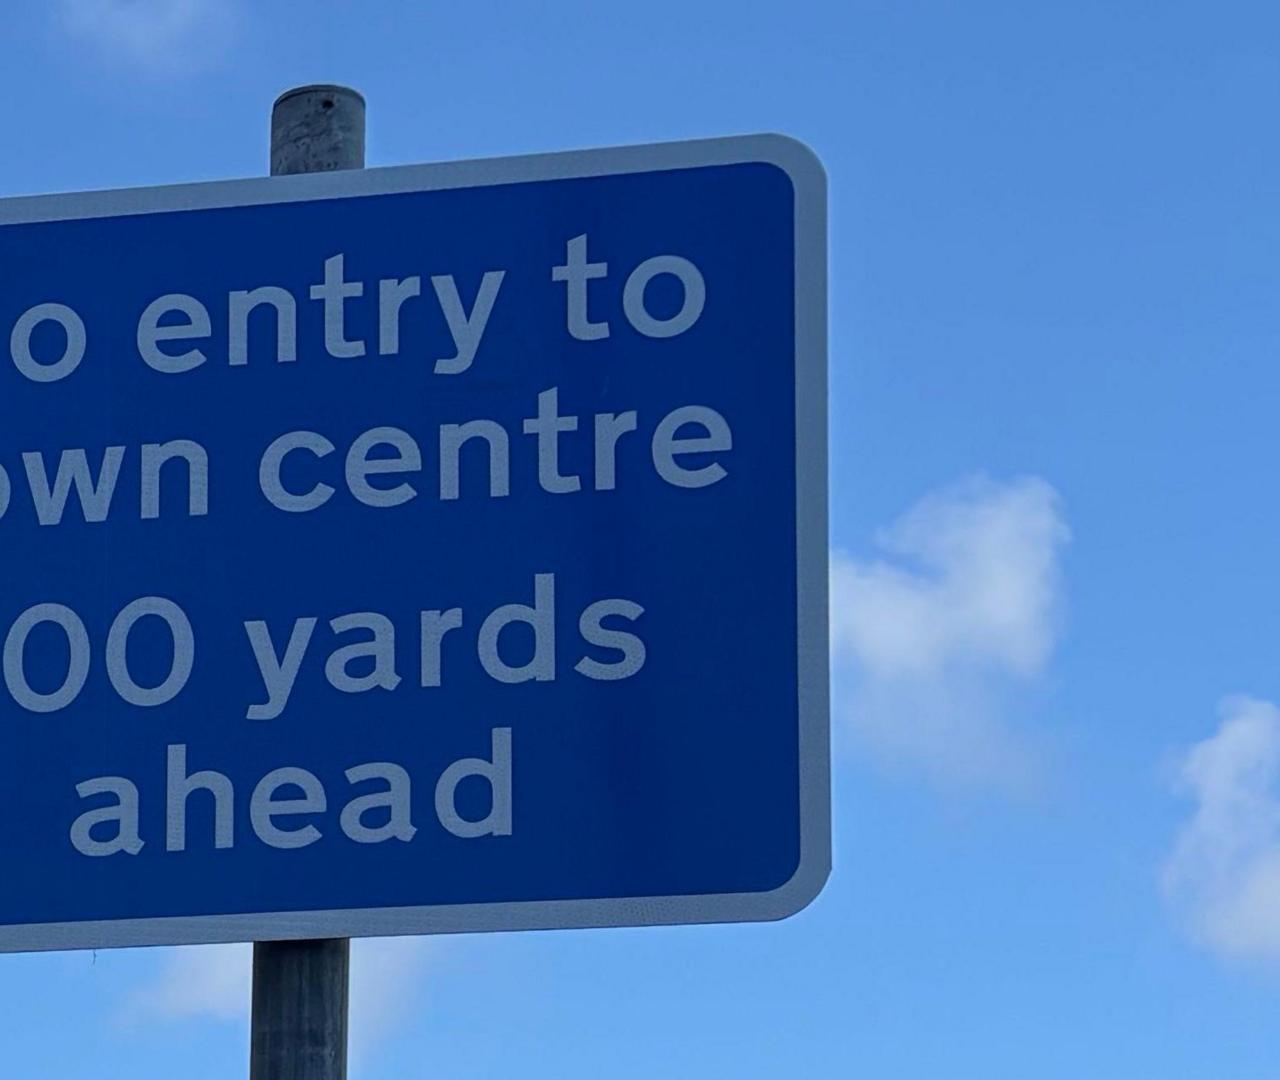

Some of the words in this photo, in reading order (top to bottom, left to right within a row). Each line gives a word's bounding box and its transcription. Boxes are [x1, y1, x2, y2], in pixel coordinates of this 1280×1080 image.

[136, 252, 506, 376] entry
[551, 233, 706, 340] to
[258, 386, 733, 514] centre
[243, 571, 646, 721] yards
[68, 726, 513, 858] ahead
